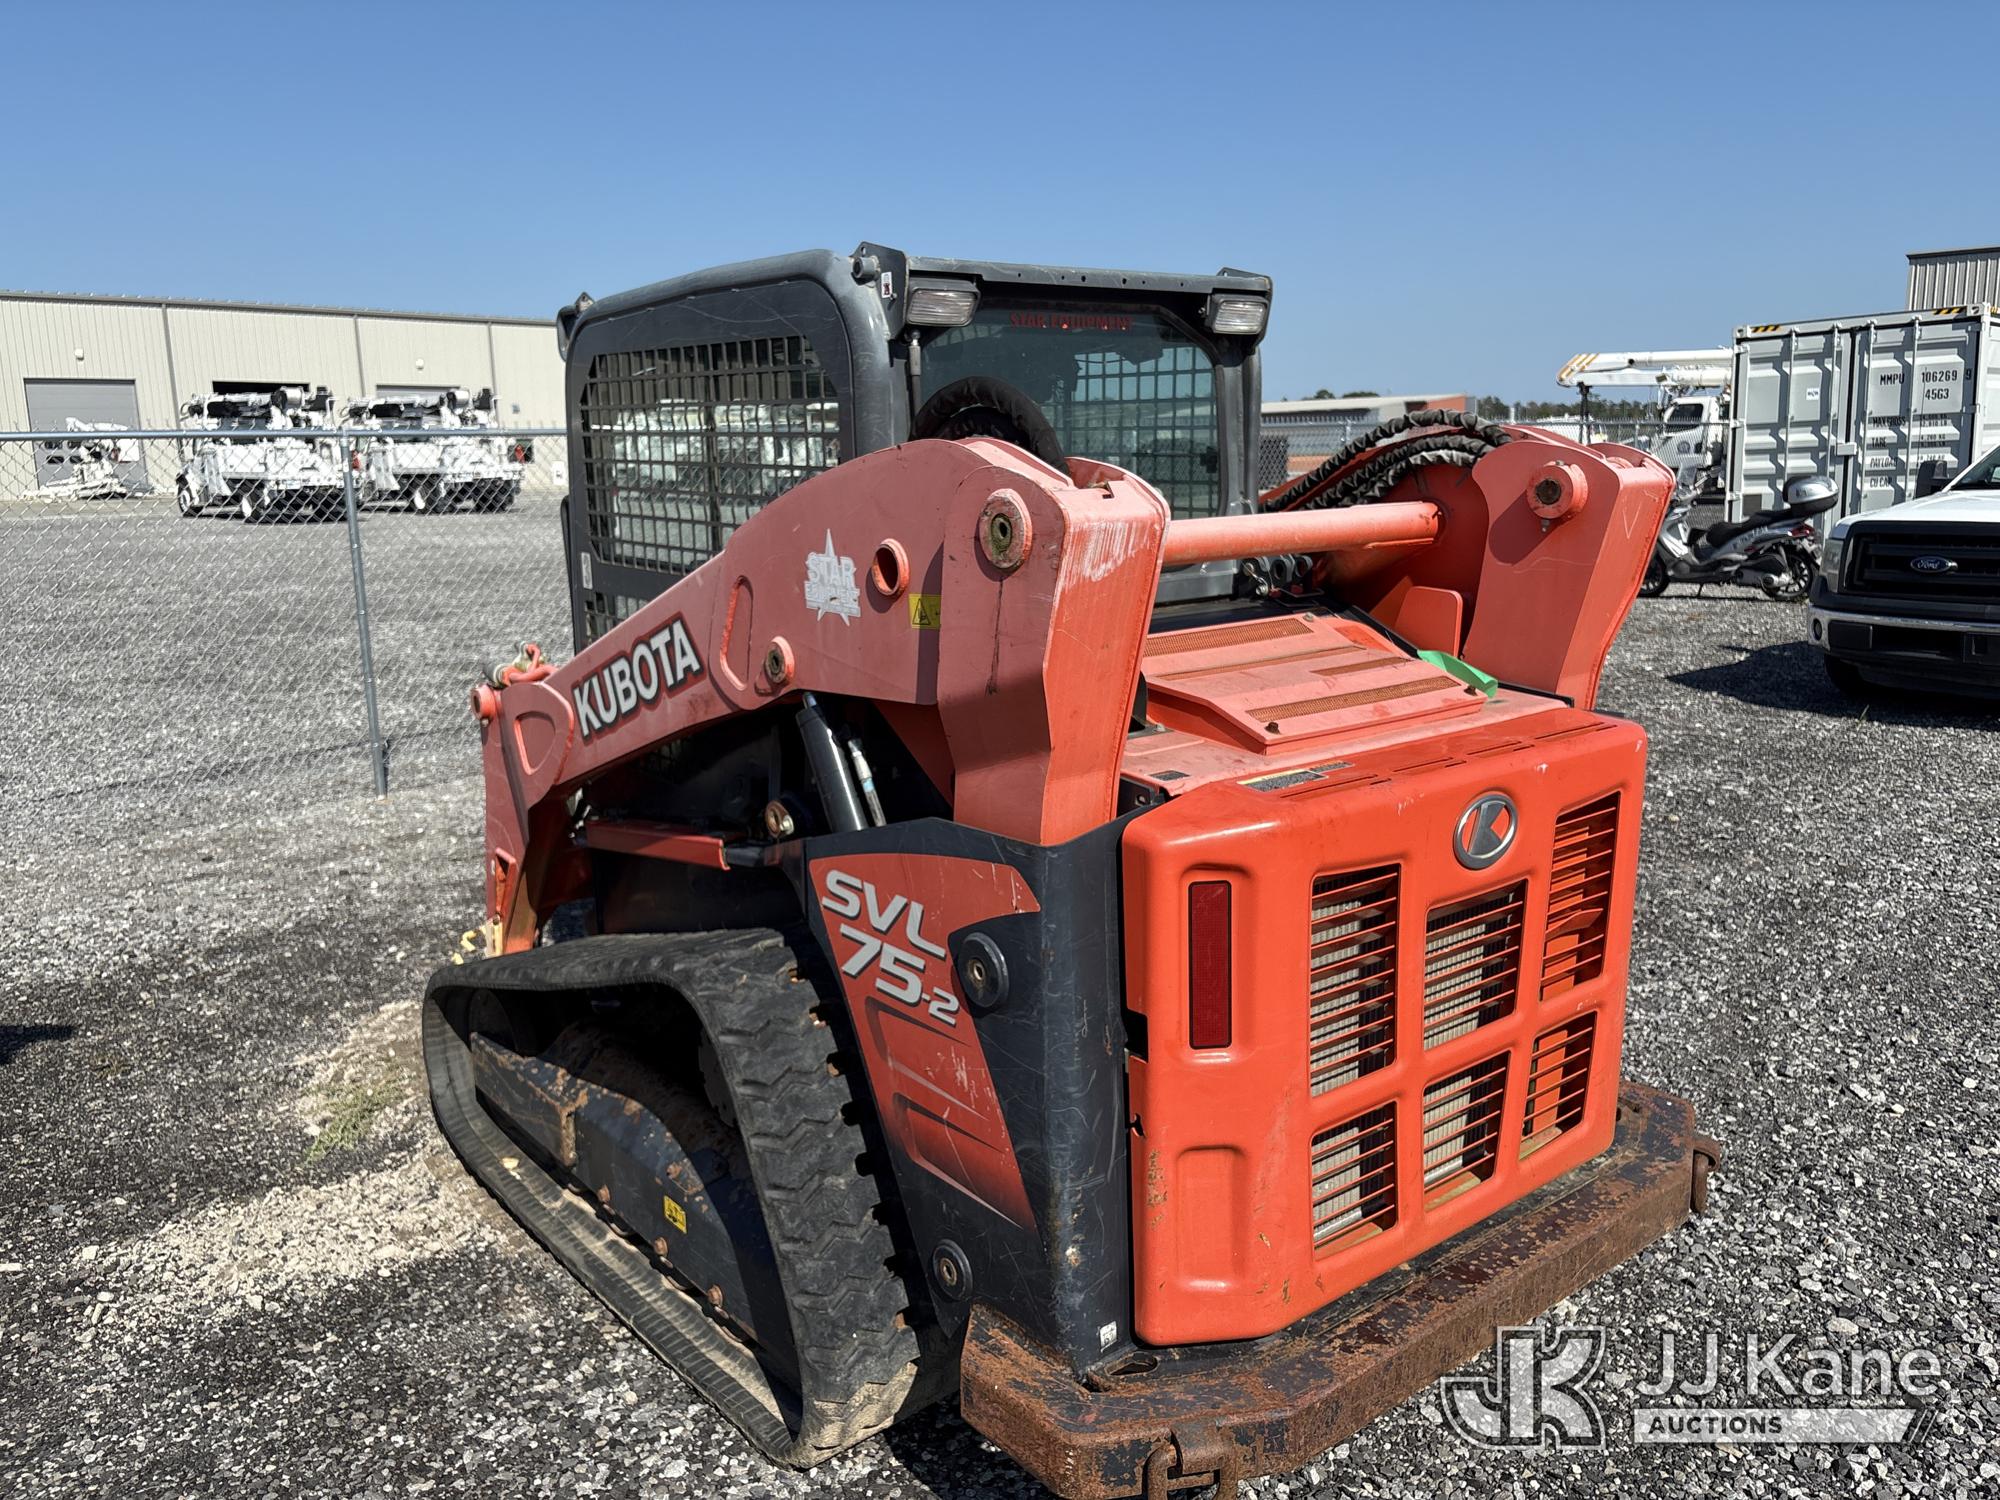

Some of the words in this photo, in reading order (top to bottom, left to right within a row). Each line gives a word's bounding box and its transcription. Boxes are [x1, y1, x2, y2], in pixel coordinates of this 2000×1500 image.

[1010, 311, 1045, 328] STAR
[1880, 373, 1905, 385] MMPU
[1921, 370, 1958, 383] 106269
[1925, 388, 1949, 400] 45G3
[572, 619, 702, 738] KUBOTA
[822, 869, 946, 960] SVL
